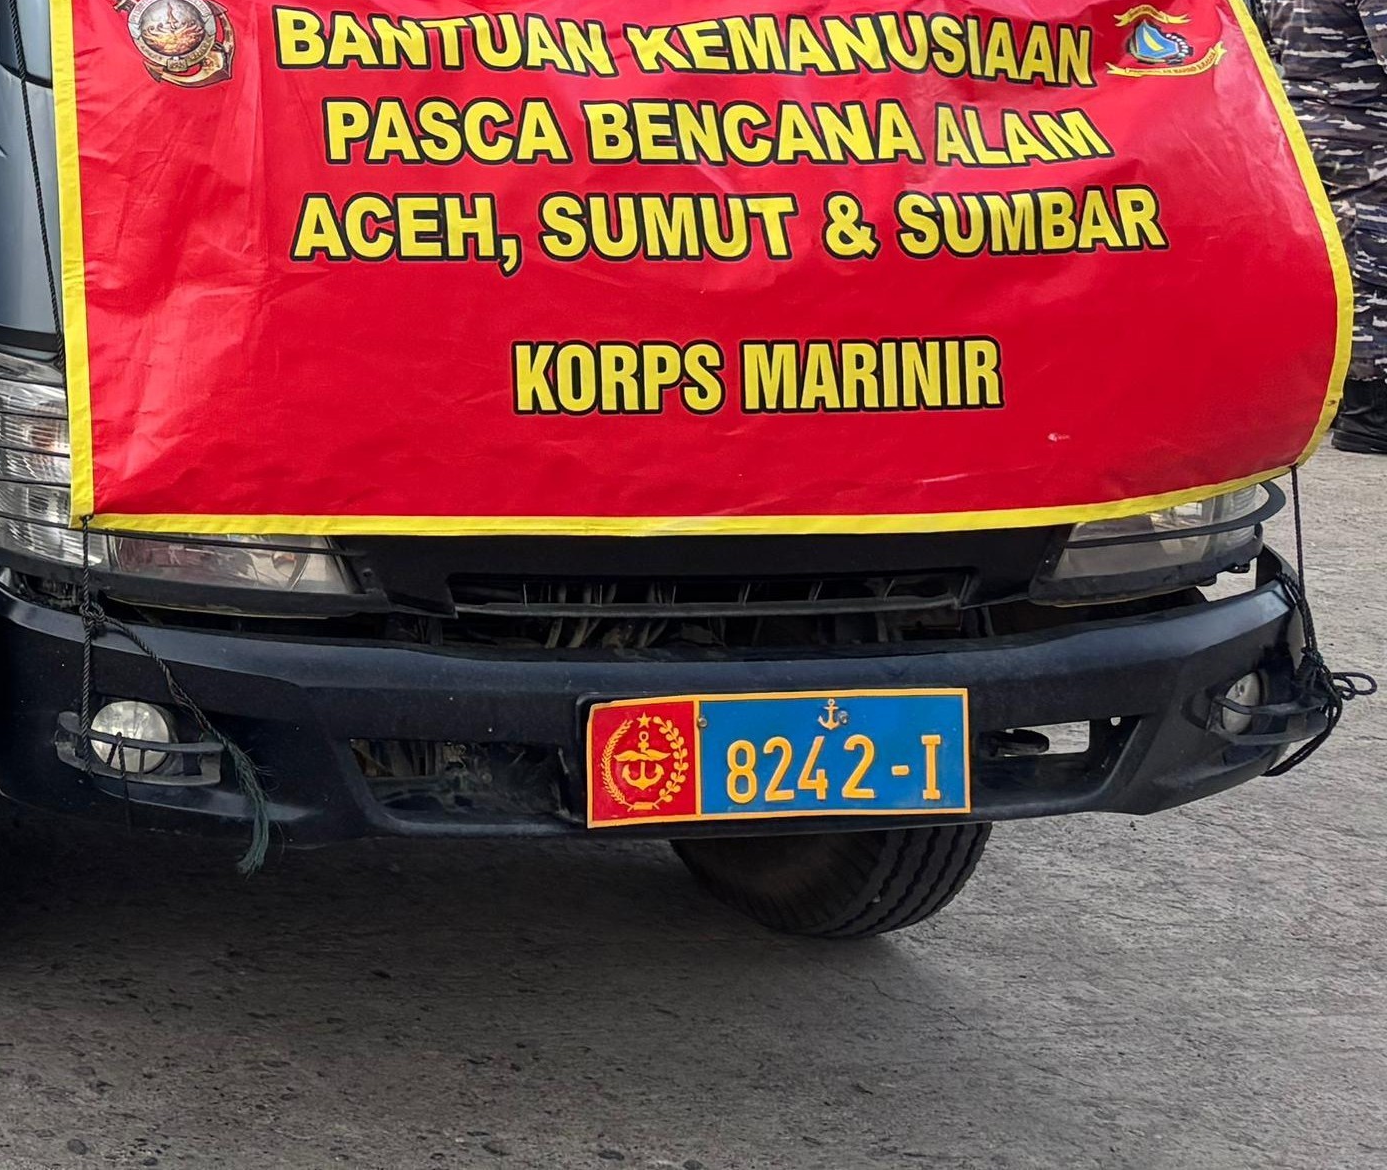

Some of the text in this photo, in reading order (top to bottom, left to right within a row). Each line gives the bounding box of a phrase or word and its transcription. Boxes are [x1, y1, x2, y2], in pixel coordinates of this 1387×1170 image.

[274, 5, 617, 78] BANTUAN
[623, 12, 1097, 89] KEMANUSIAAN
[322, 96, 1115, 169] PASCA BENCANA ALAM
[289, 183, 1170, 278] ACEH, SUMUT & SUMBAR
[511, 334, 1006, 417] KORPS MARINIR
